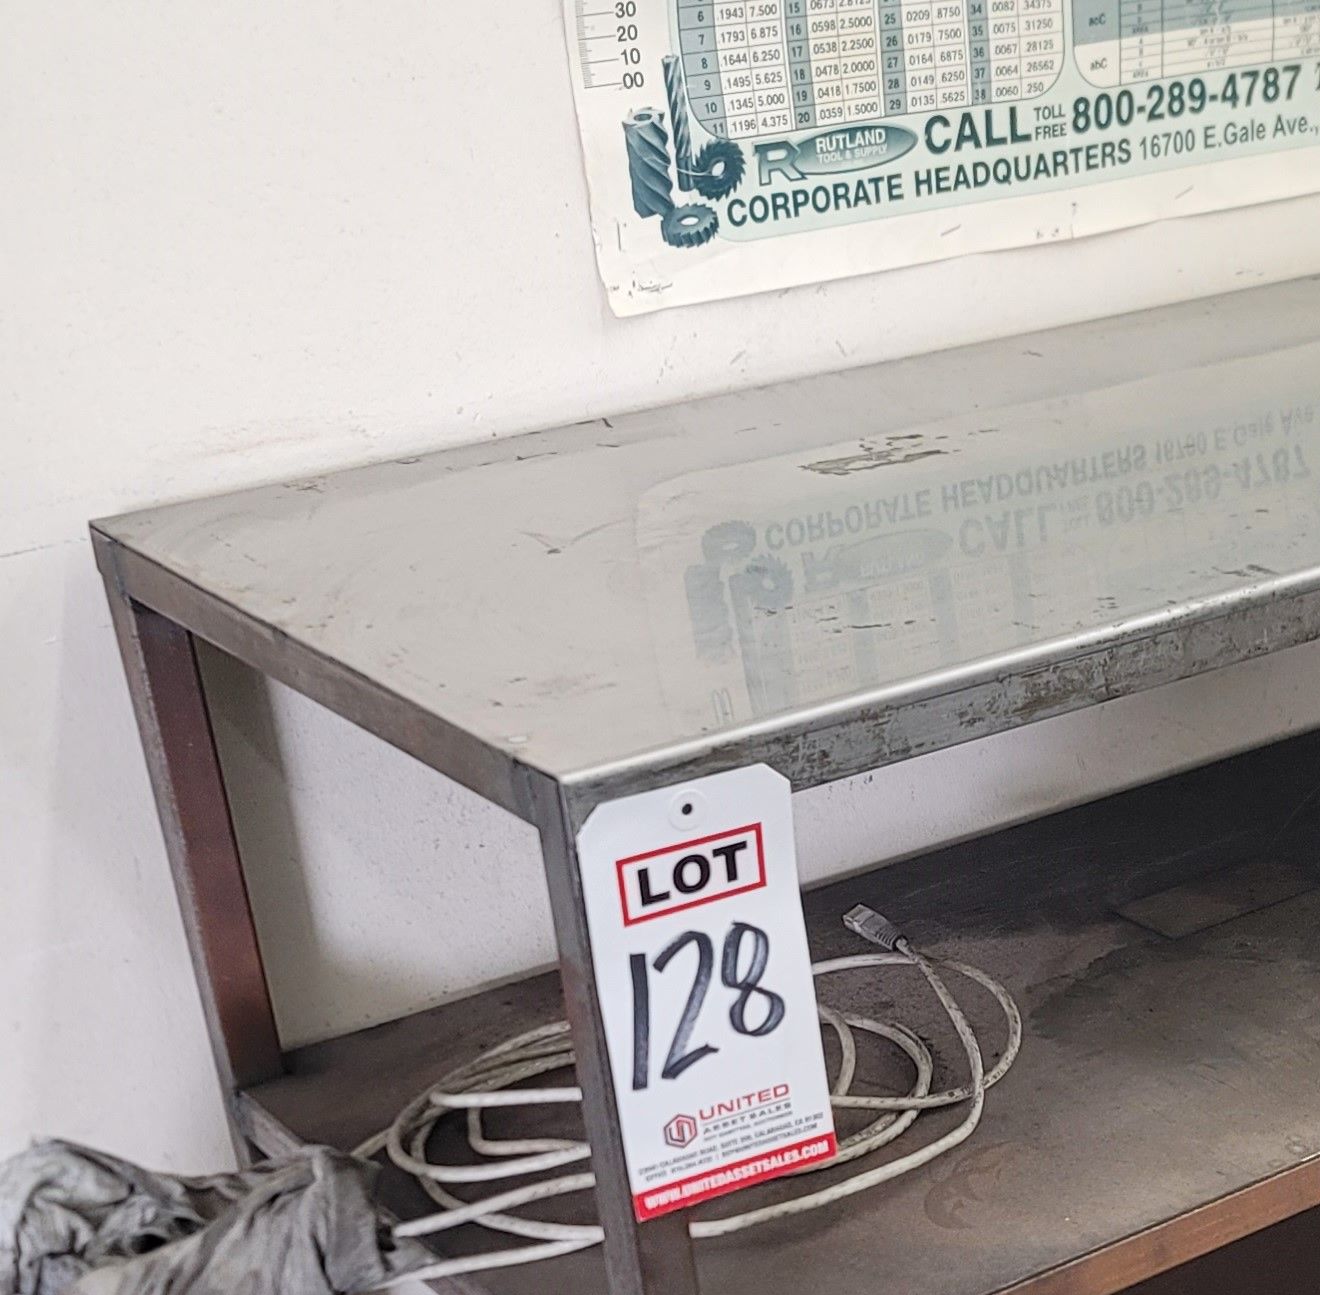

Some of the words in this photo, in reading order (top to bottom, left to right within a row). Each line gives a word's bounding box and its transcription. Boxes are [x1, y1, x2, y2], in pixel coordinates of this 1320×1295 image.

[615, 1, 636, 18] 30
[789, 1, 800, 14] 15
[697, 11, 704, 22] 6
[884, 13, 896, 25] 25
[617, 24, 638, 42] 20
[790, 24, 800, 36] 16
[699, 34, 705, 45] 7
[886, 36, 897, 47] 26
[621, 48, 640, 65] 10
[792, 46, 802, 57] 17
[701, 57, 708, 69] 8
[623, 72, 644, 89] 00
[794, 69, 805, 81] 18
[704, 80, 711, 91] 9
[888, 78, 899, 89] 28
[796, 90, 807, 102] 19
[1072, 64, 1301, 135] 800-289-4787
[705, 102, 717, 114] 10
[890, 99, 901, 110] 29
[798, 112, 809, 123] 20
[1033, 104, 1066, 122] TOLL
[713, 122, 724, 134] 11
[925, 105, 1032, 154] CALL
[1034, 122, 1067, 141] FREE
[815, 128, 887, 153] RUTLAND
[817, 152, 843, 165] TOOL
[854, 144, 888, 159] SUPPLY
[727, 173, 905, 228] CORPORATE
[914, 141, 1132, 198] HEADQUARTERS
[1139, 129, 1195, 161] 16700
[1203, 119, 1267, 151] E.Gale
[1272, 113, 1319, 139] Ave.,
[637, 841, 747, 906] LOT
[629, 920, 785, 1091] 128
[699, 1083, 789, 1120] UNITED
